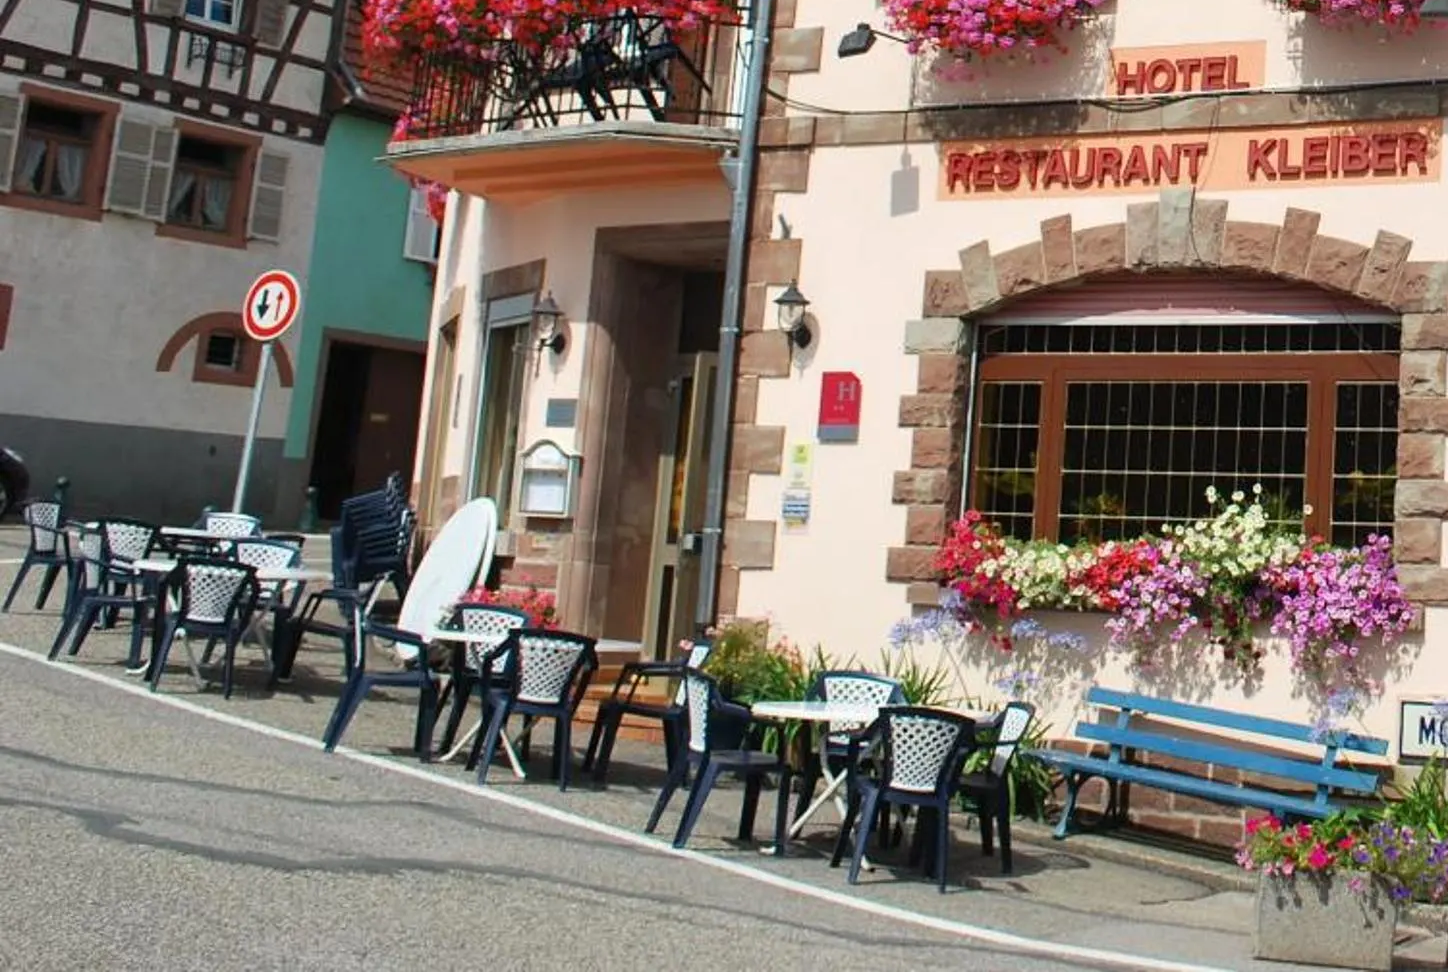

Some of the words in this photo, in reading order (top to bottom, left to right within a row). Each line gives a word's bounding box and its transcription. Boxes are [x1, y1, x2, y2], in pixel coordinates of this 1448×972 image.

[1115, 54, 1250, 95] HOTEL
[946, 142, 1208, 192] RESTAURANT
[1246, 131, 1430, 181] KLEIBER
